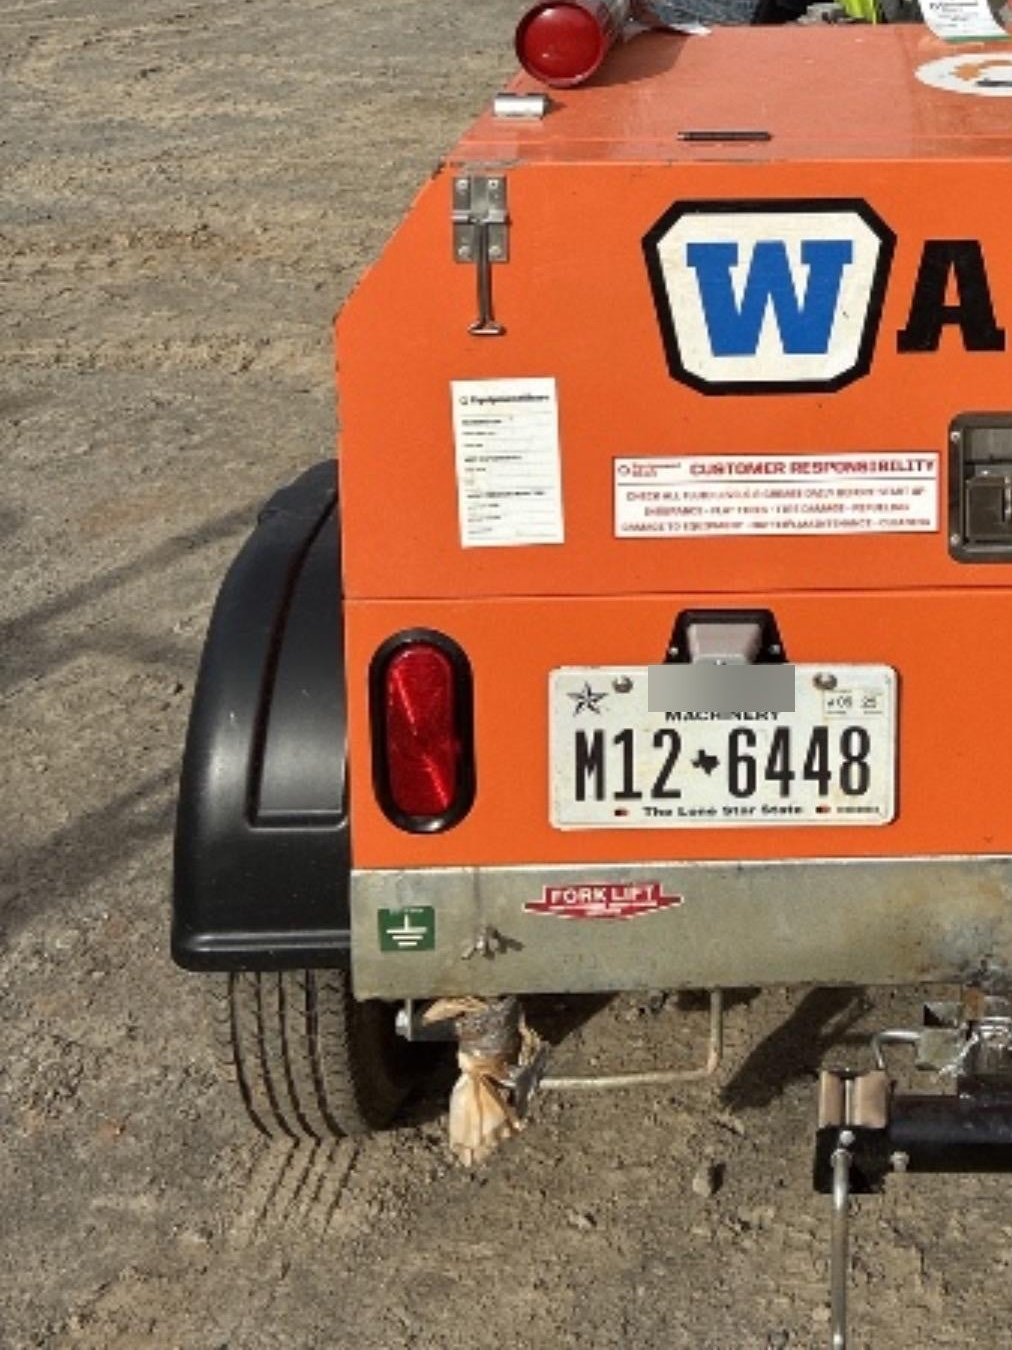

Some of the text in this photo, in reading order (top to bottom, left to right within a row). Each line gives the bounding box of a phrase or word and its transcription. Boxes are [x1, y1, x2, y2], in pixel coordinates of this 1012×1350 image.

[689, 458, 936, 476] CUSTOMER RESPONSIBILITY
[551, 885, 654, 904] FORK LIFT
